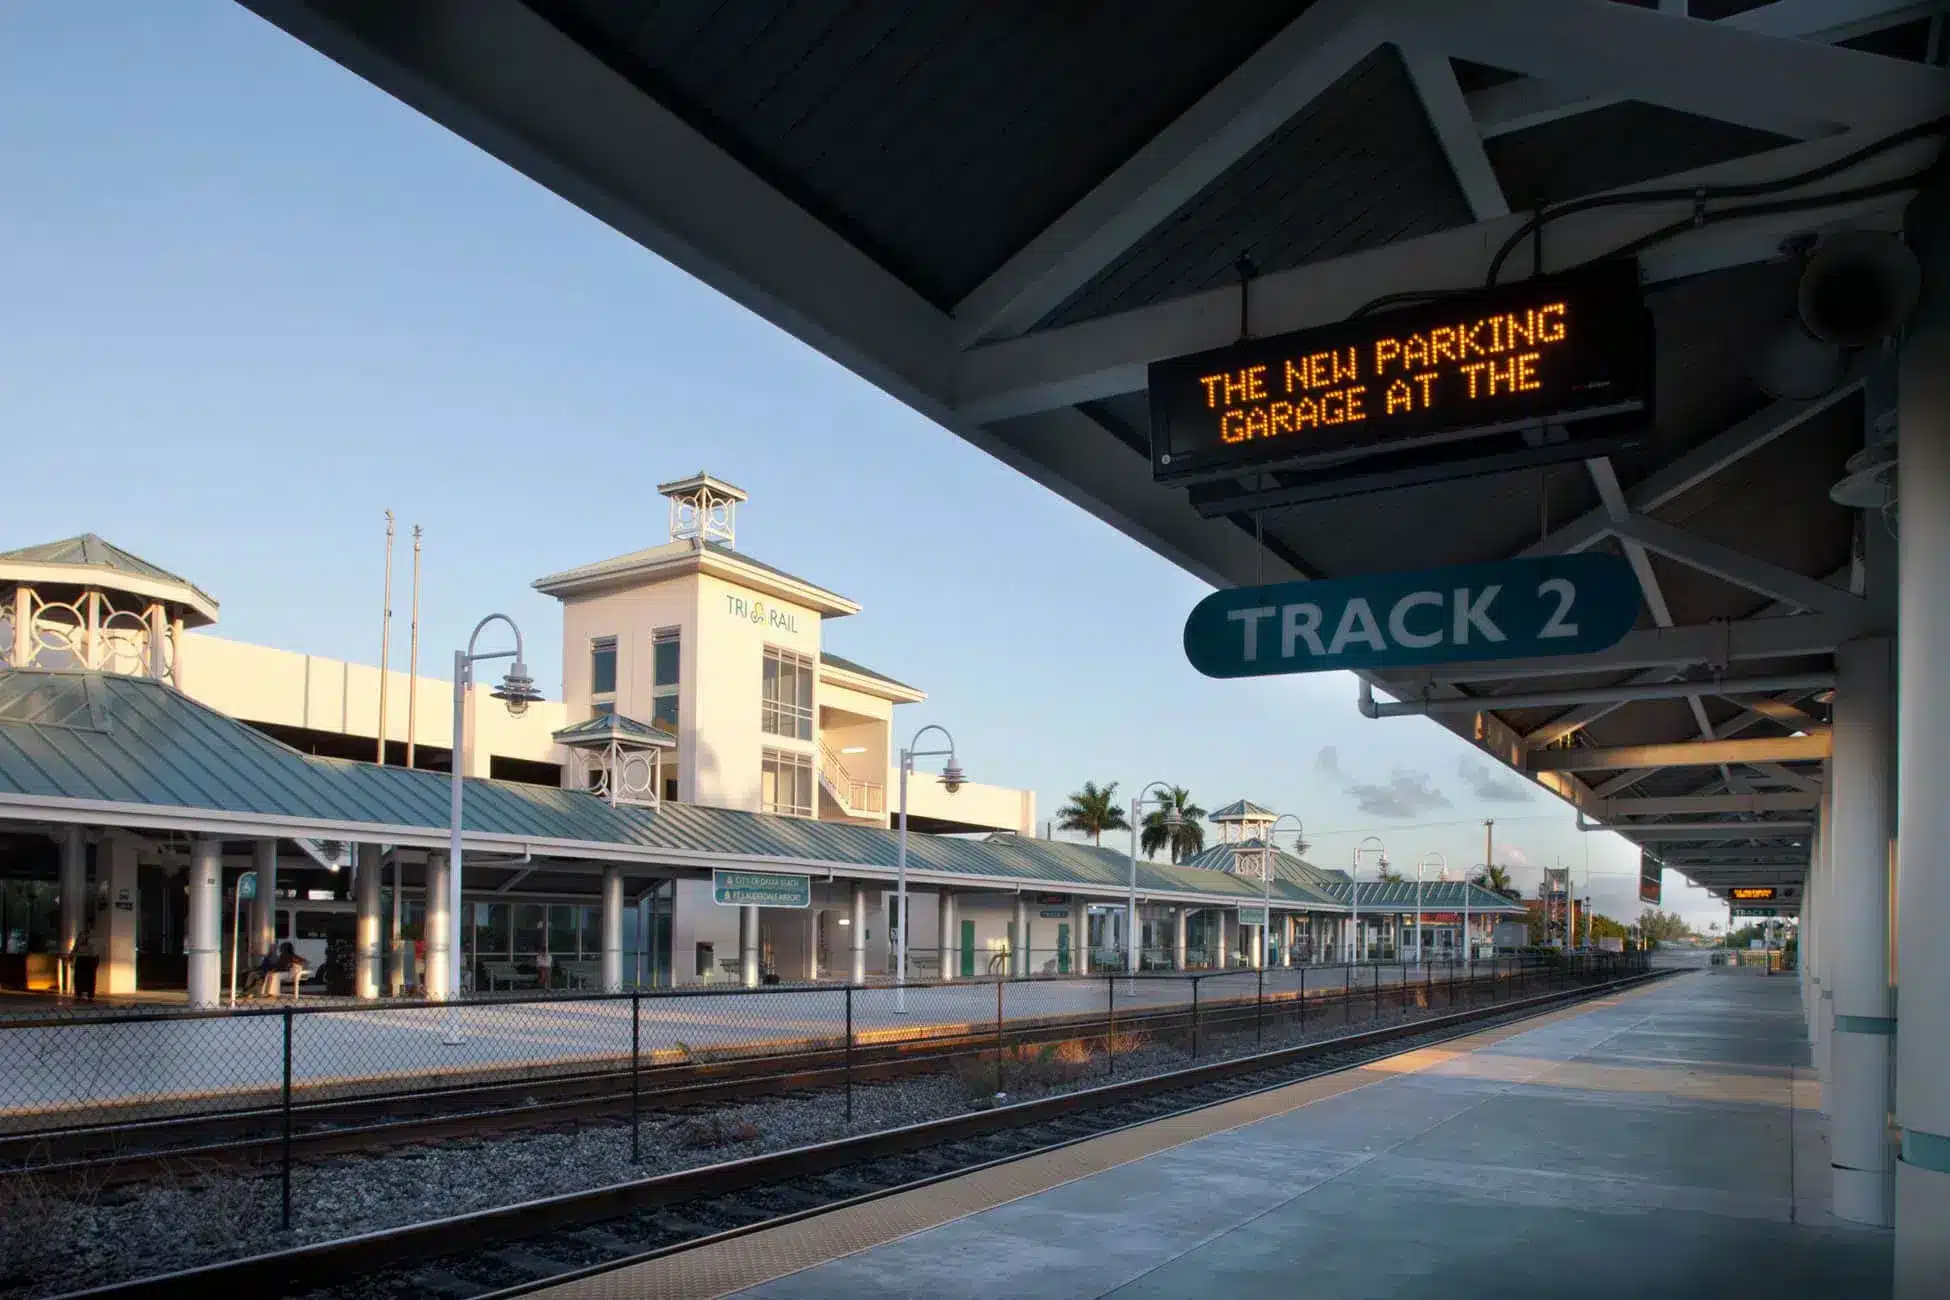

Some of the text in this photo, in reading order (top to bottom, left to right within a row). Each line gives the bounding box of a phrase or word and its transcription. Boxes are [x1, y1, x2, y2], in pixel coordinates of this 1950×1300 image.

[1199, 302, 1566, 409] THE NEW PARKING
[1221, 351, 1542, 444] GARAGE AT THE
[726, 595, 798, 633] TRI RAIL
[1227, 579, 1579, 662] TRACK 2
